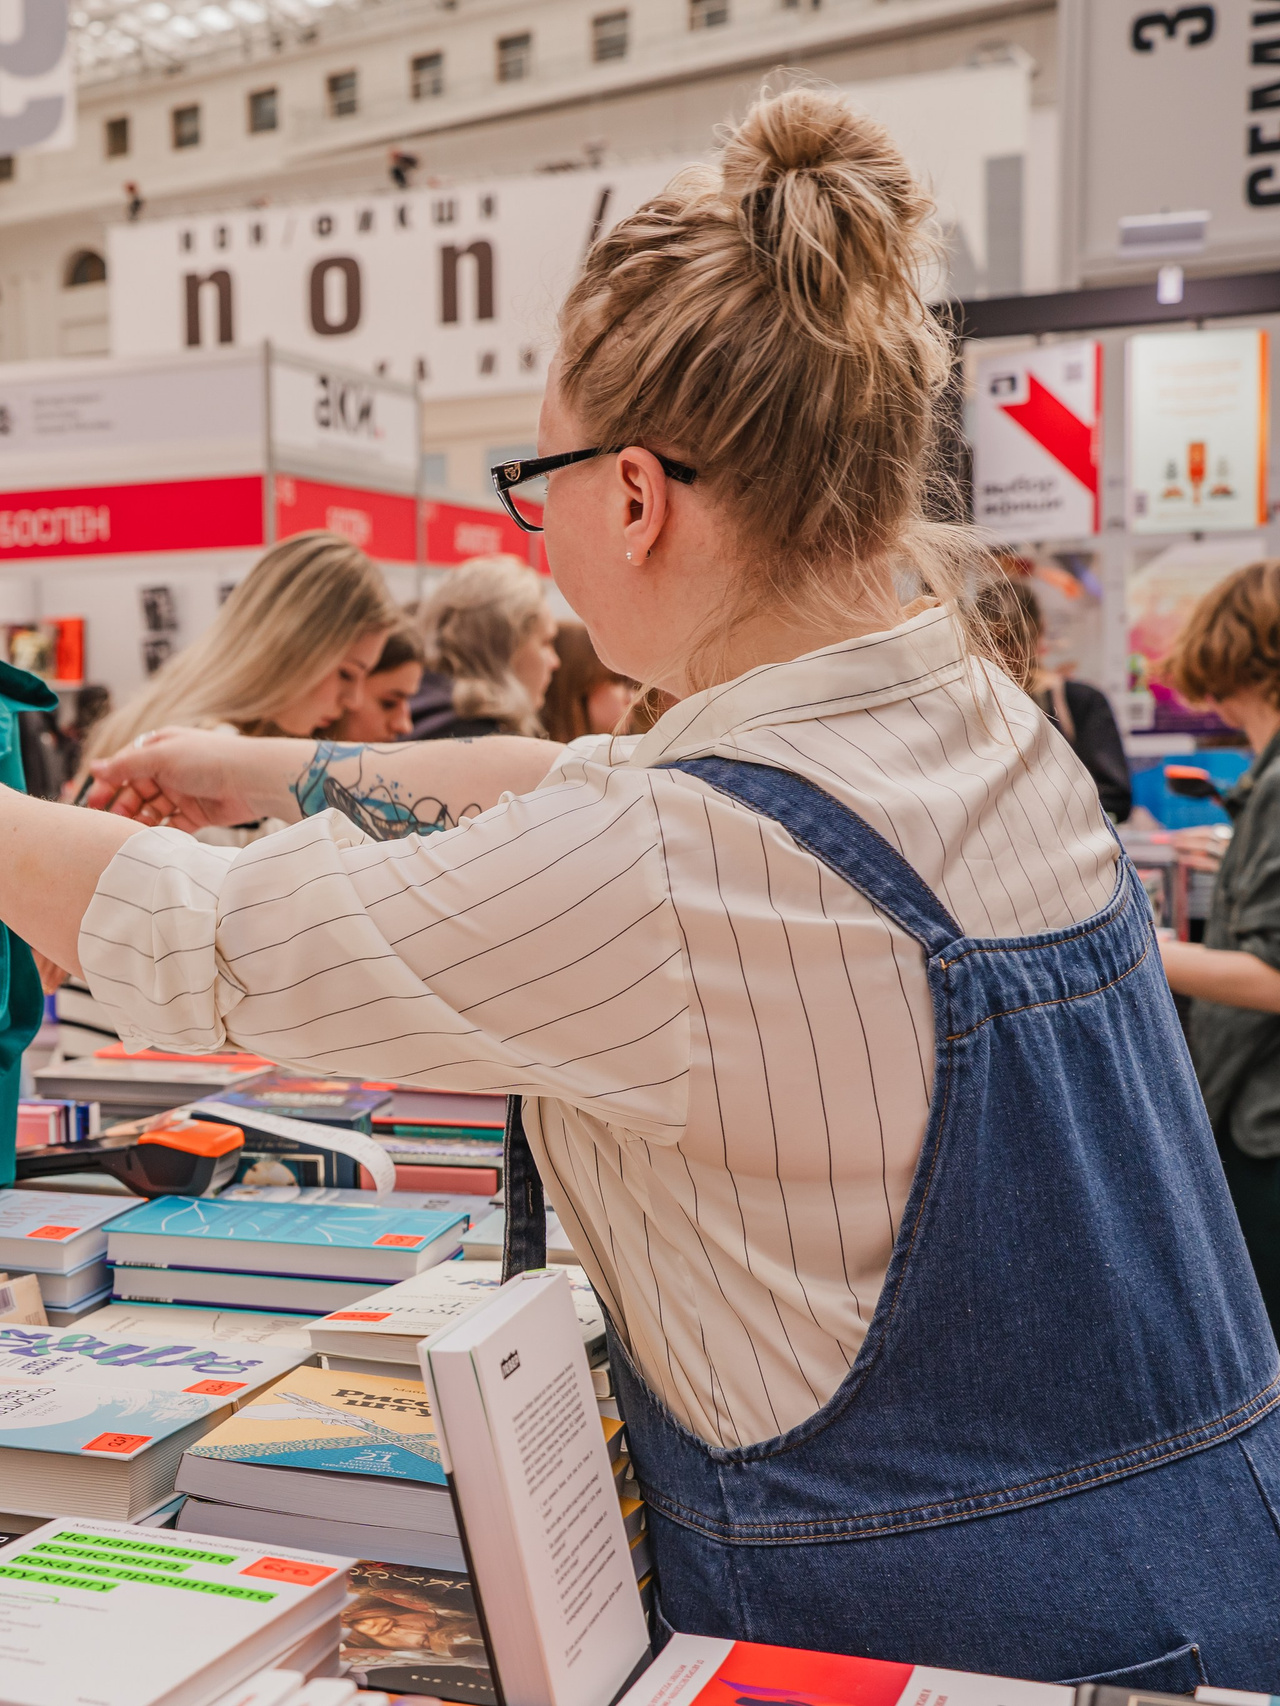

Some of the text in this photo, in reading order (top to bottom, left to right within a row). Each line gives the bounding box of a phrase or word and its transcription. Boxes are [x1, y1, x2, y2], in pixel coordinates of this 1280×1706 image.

[354, 1451, 393, 1464] 21
[31, 1544, 183, 1573] ассистента,
[53, 1531, 235, 1564] Не нанимайте
[10, 1556, 275, 1601] пока не прочитаете
[38, 1575, 119, 1592] книгу
